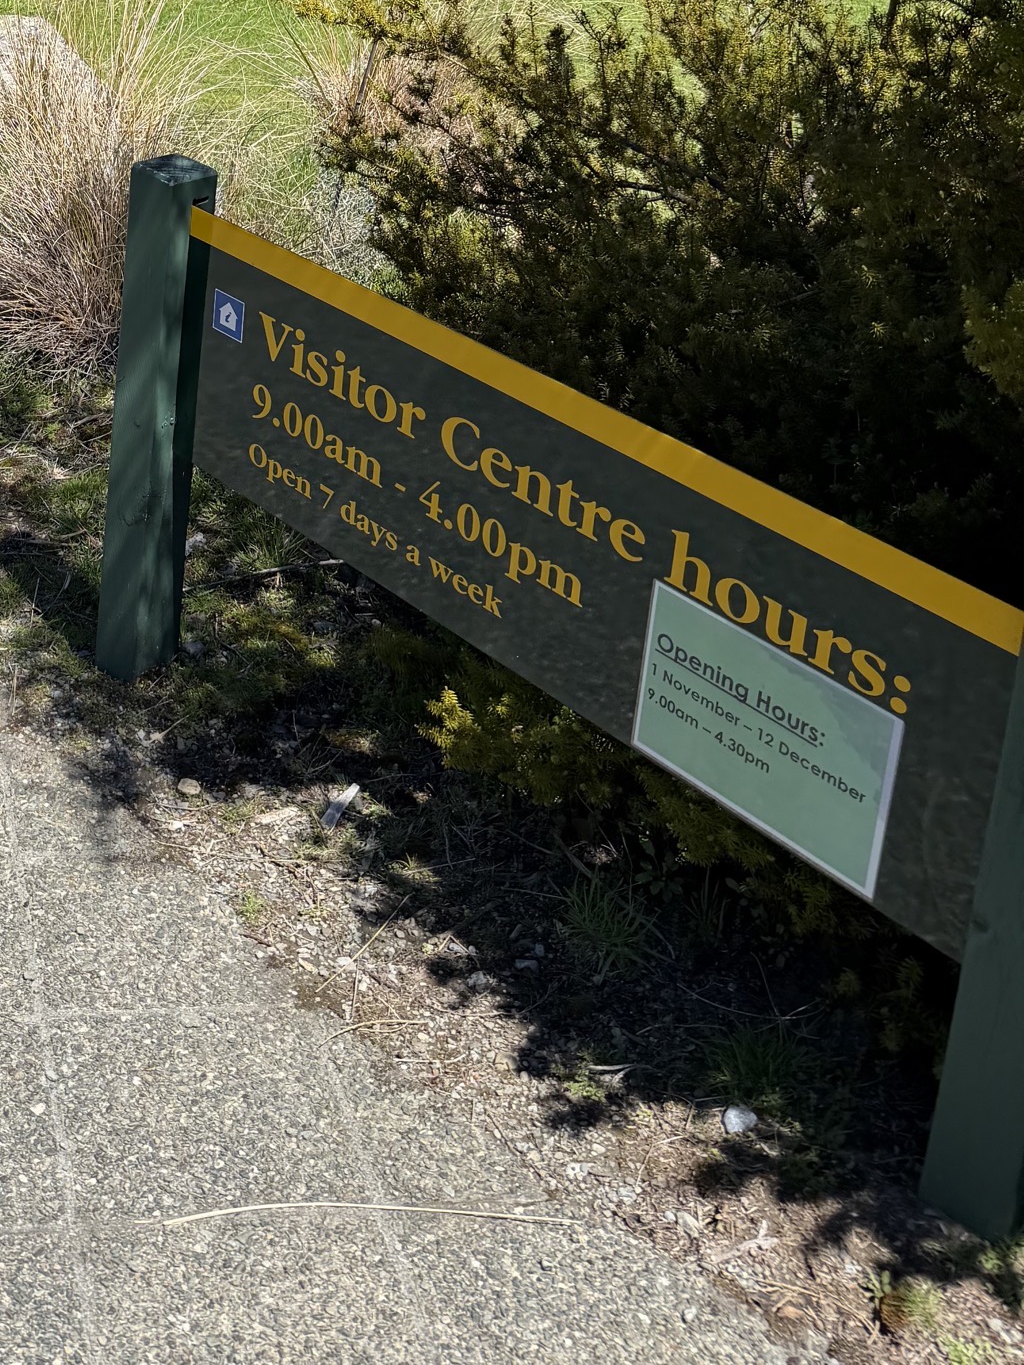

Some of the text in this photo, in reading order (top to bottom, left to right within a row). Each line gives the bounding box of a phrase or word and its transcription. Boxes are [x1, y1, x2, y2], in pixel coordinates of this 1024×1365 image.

[248, 443, 502, 619] Open 7 days a week
[252, 384, 382, 488] 9.00am
[419, 481, 583, 608] 4.00pm
[259, 311, 911, 715] Visitor Centre hours:
[647, 687, 699, 730] 9.00am
[714, 731, 770, 774] 4.30pm
[651, 663, 658, 676] 1
[663, 669, 741, 727] November
[757, 727, 774, 748] 12
[778, 741, 866, 803] December
[657, 633, 825, 747] Opening Hours:
